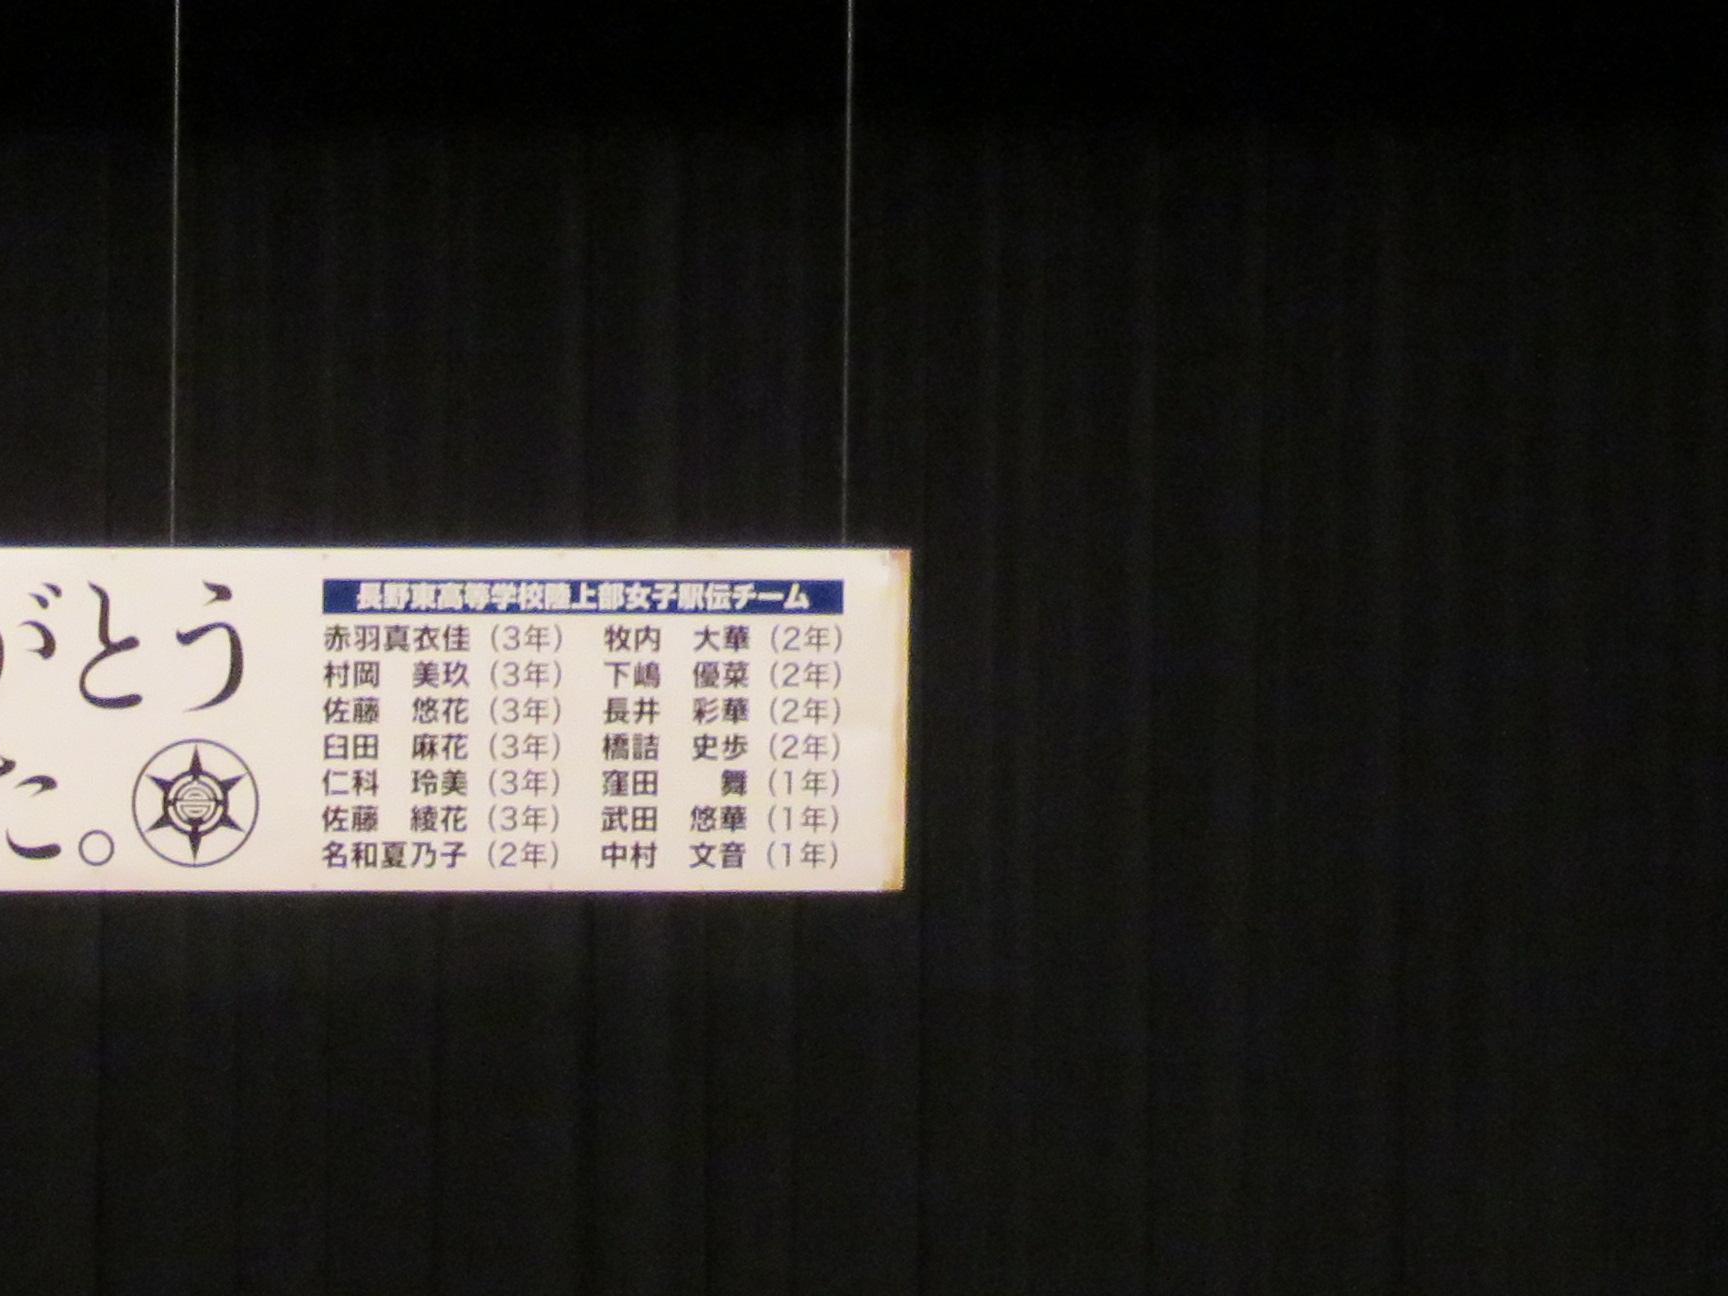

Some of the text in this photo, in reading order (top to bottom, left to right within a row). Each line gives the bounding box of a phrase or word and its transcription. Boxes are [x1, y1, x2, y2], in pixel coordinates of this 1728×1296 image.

[357, 581, 811, 612] 長野東高等学校陸上部女子駅伝チーム
[324, 624, 471, 653] 赤羽真衣佳
[604, 624, 663, 653] 牧内
[324, 661, 382, 689] 村岡
[413, 661, 471, 690] 美玖
[323, 696, 382, 725] 佐藤
[604, 697, 662, 725] 長井
[323, 733, 381, 761] 臼田
[411, 732, 470, 762] 麻花
[602, 732, 661, 762] 橋詰
[692, 733, 750, 762] 史歩
[322, 769, 381, 798] 仁科
[411, 769, 469, 797] 玲美
[721, 769, 750, 798] 舞
[321, 805, 380, 834] 佐藤
[601, 805, 660, 834] 武田
[322, 840, 469, 870] 名和夏乃子
[601, 841, 660, 870] 中村
[689, 840, 748, 870] 文音
